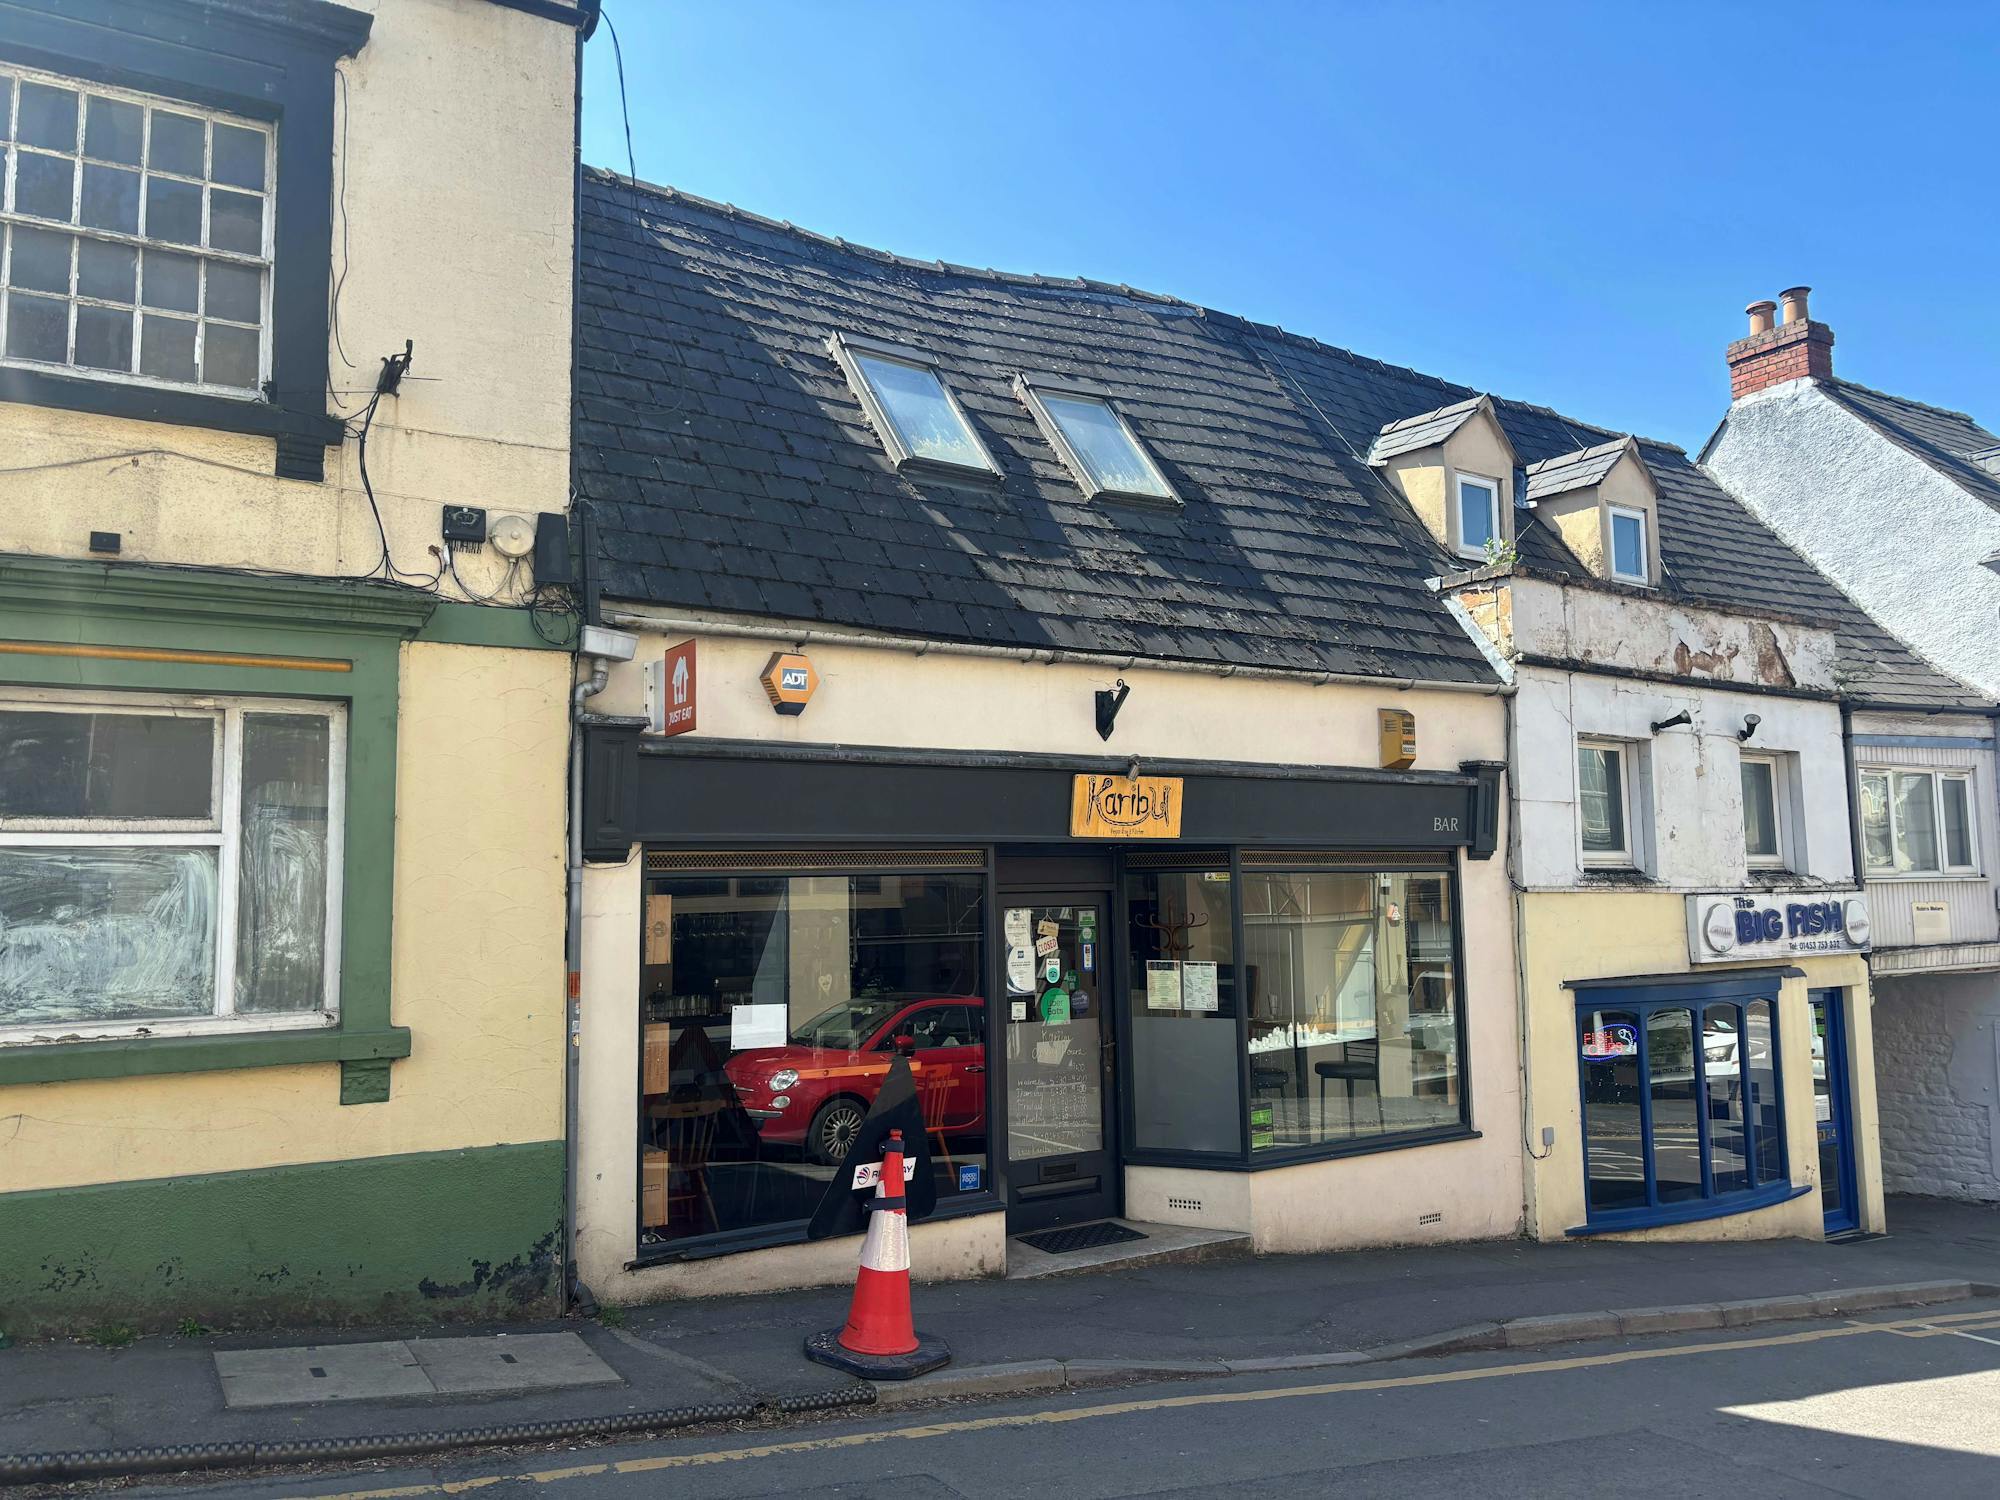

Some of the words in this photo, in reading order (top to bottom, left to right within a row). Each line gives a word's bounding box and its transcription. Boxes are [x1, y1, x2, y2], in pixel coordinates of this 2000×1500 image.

[782, 673, 808, 686] ADT
[669, 708, 681, 727] JUST
[682, 706, 693, 721] EAT
[1086, 776, 1171, 827] Karibu
[1433, 817, 1459, 832] BAR
[1733, 897, 1755, 909] The
[1735, 908, 1784, 945] BIG
[1786, 900, 1843, 939] FISH
[1038, 938, 1057, 954] CLOSED
[1799, 941, 1817, 950] 01453
